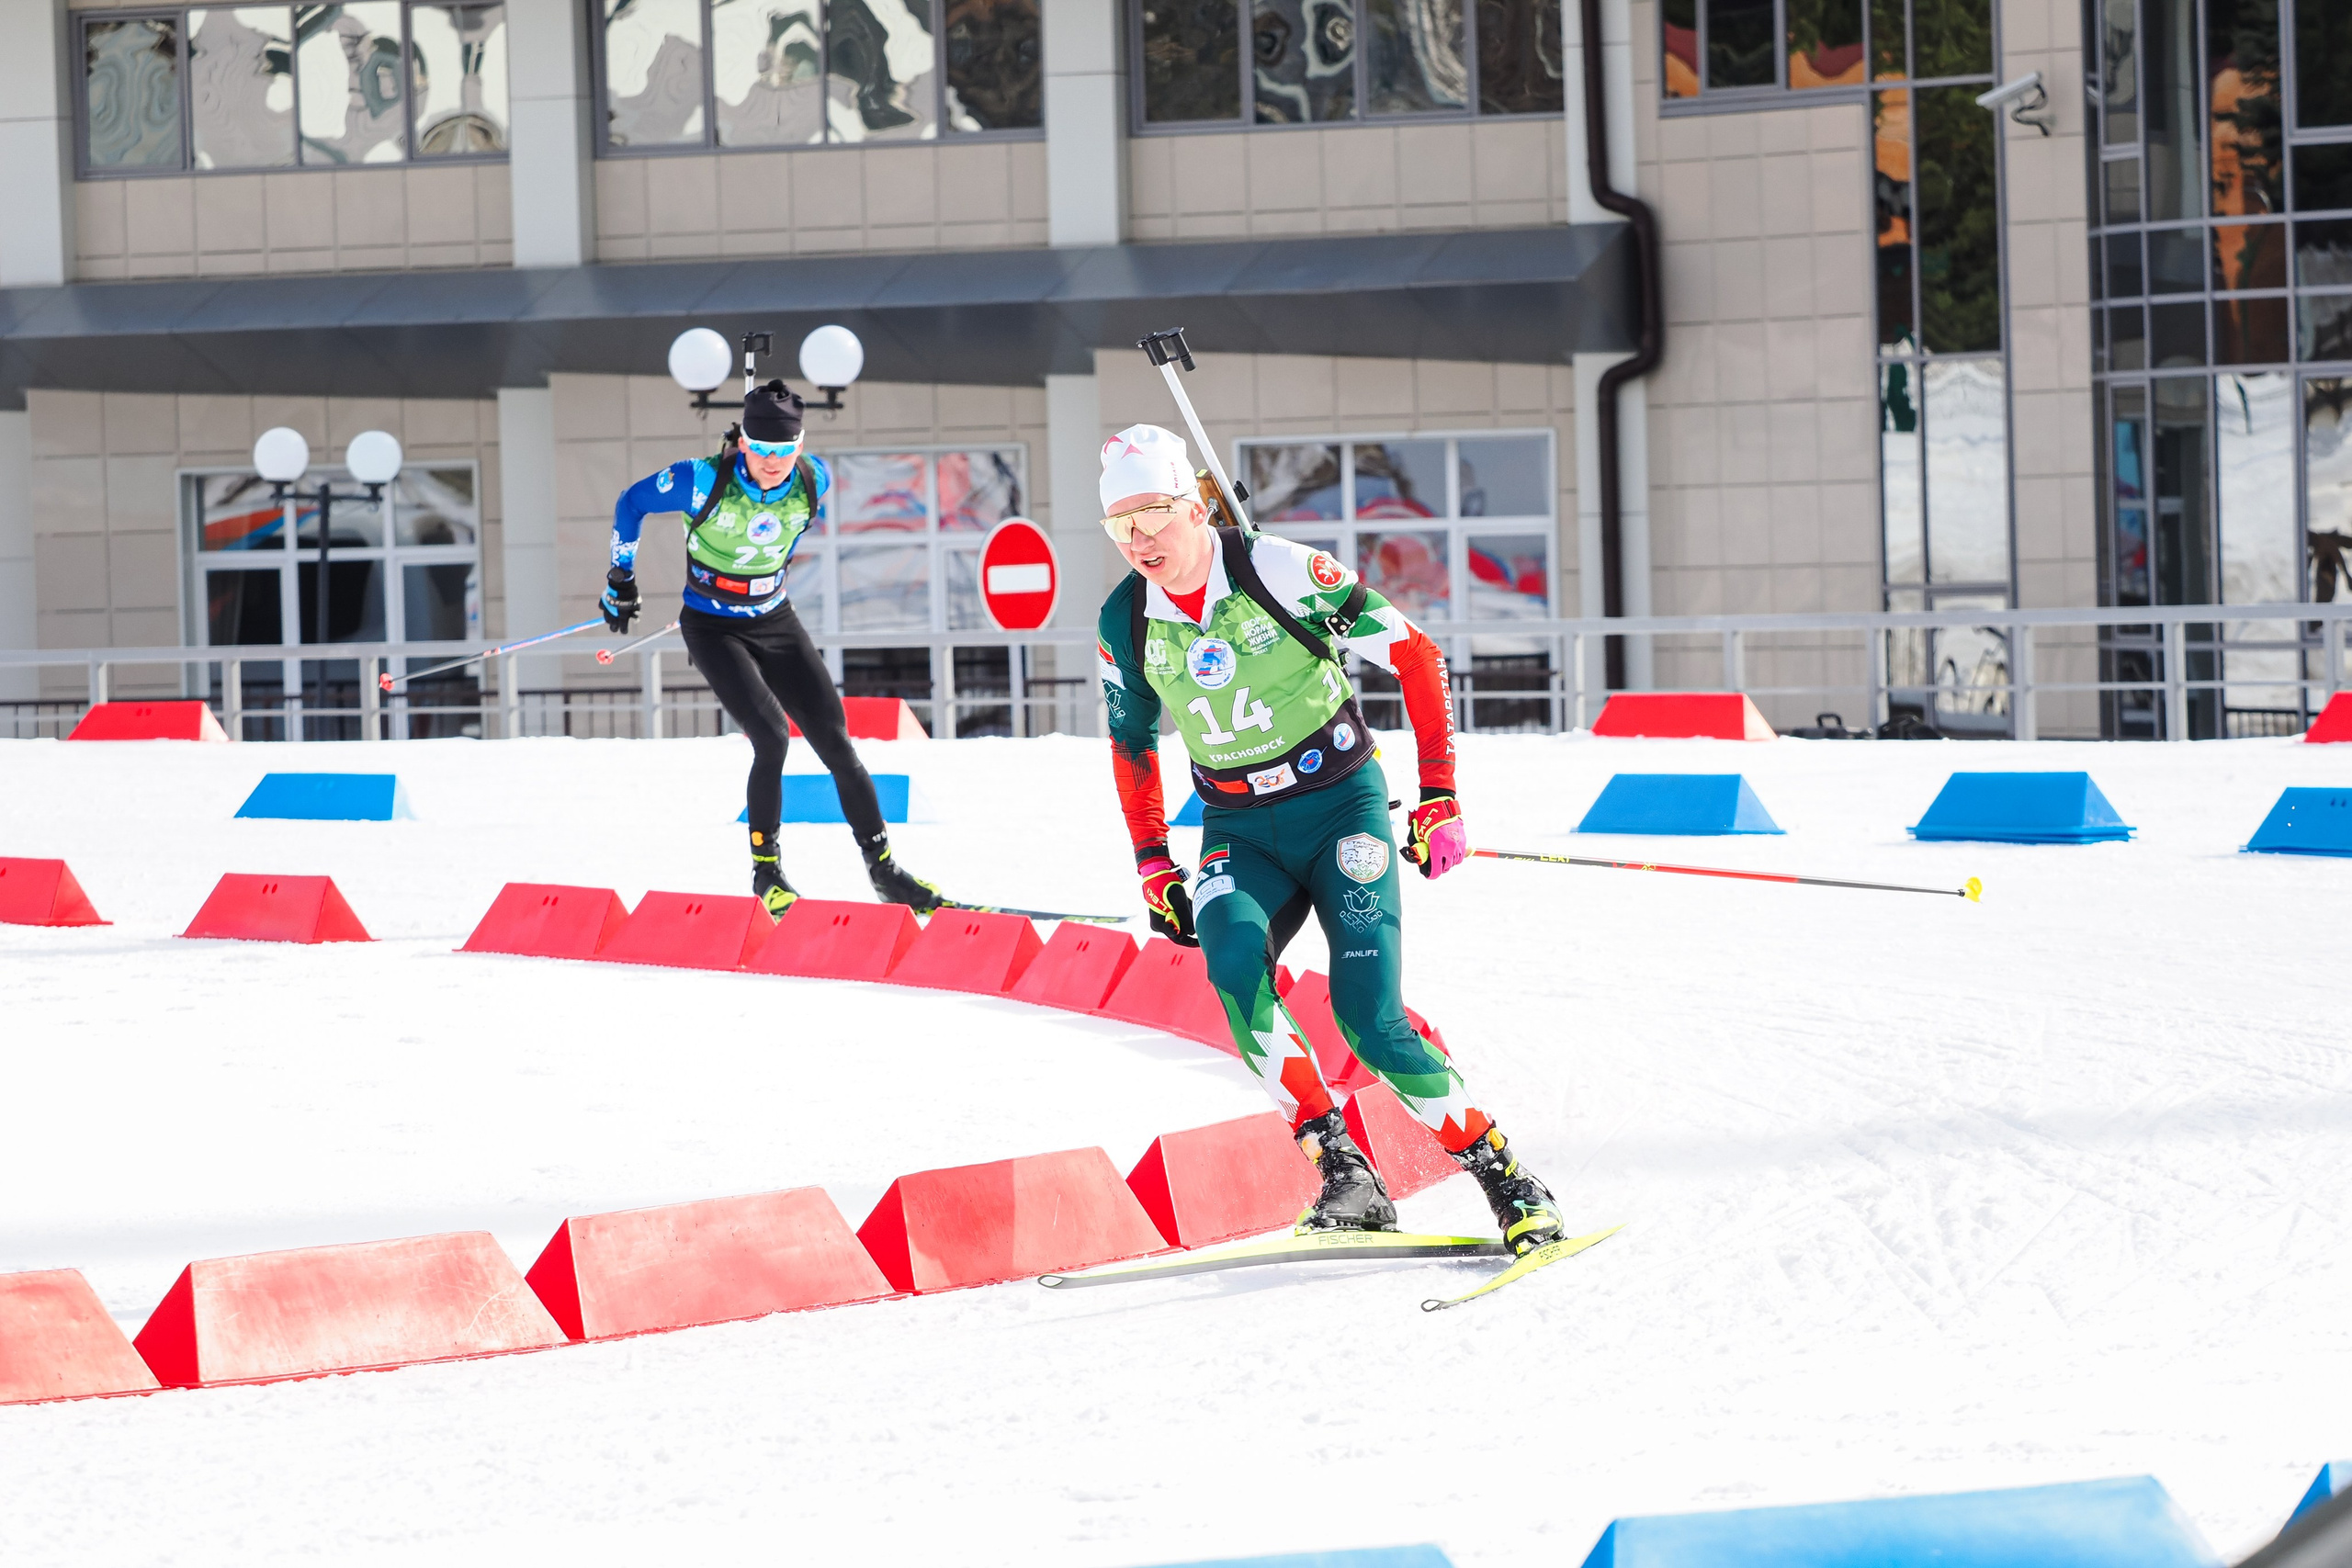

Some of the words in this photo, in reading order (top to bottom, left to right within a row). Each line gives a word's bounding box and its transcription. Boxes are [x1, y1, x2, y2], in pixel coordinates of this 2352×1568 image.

[734, 545, 786, 565] 23
[1243, 621, 1273, 638] НОРМА
[1248, 629, 1278, 647] ЖИЗНИ
[1186, 686, 1275, 746] 14
[1436, 657, 1455, 755] ТАТАРСТАН
[1209, 736, 1285, 762] КРАСНОЯРСК
[1419, 808, 1439, 840] LEKI
[1540, 853, 1570, 863] LEKI
[1148, 887, 1168, 911] LEKI
[1342, 949, 1379, 958] FANLIFE
[1317, 1234, 1374, 1246] FISCHER
